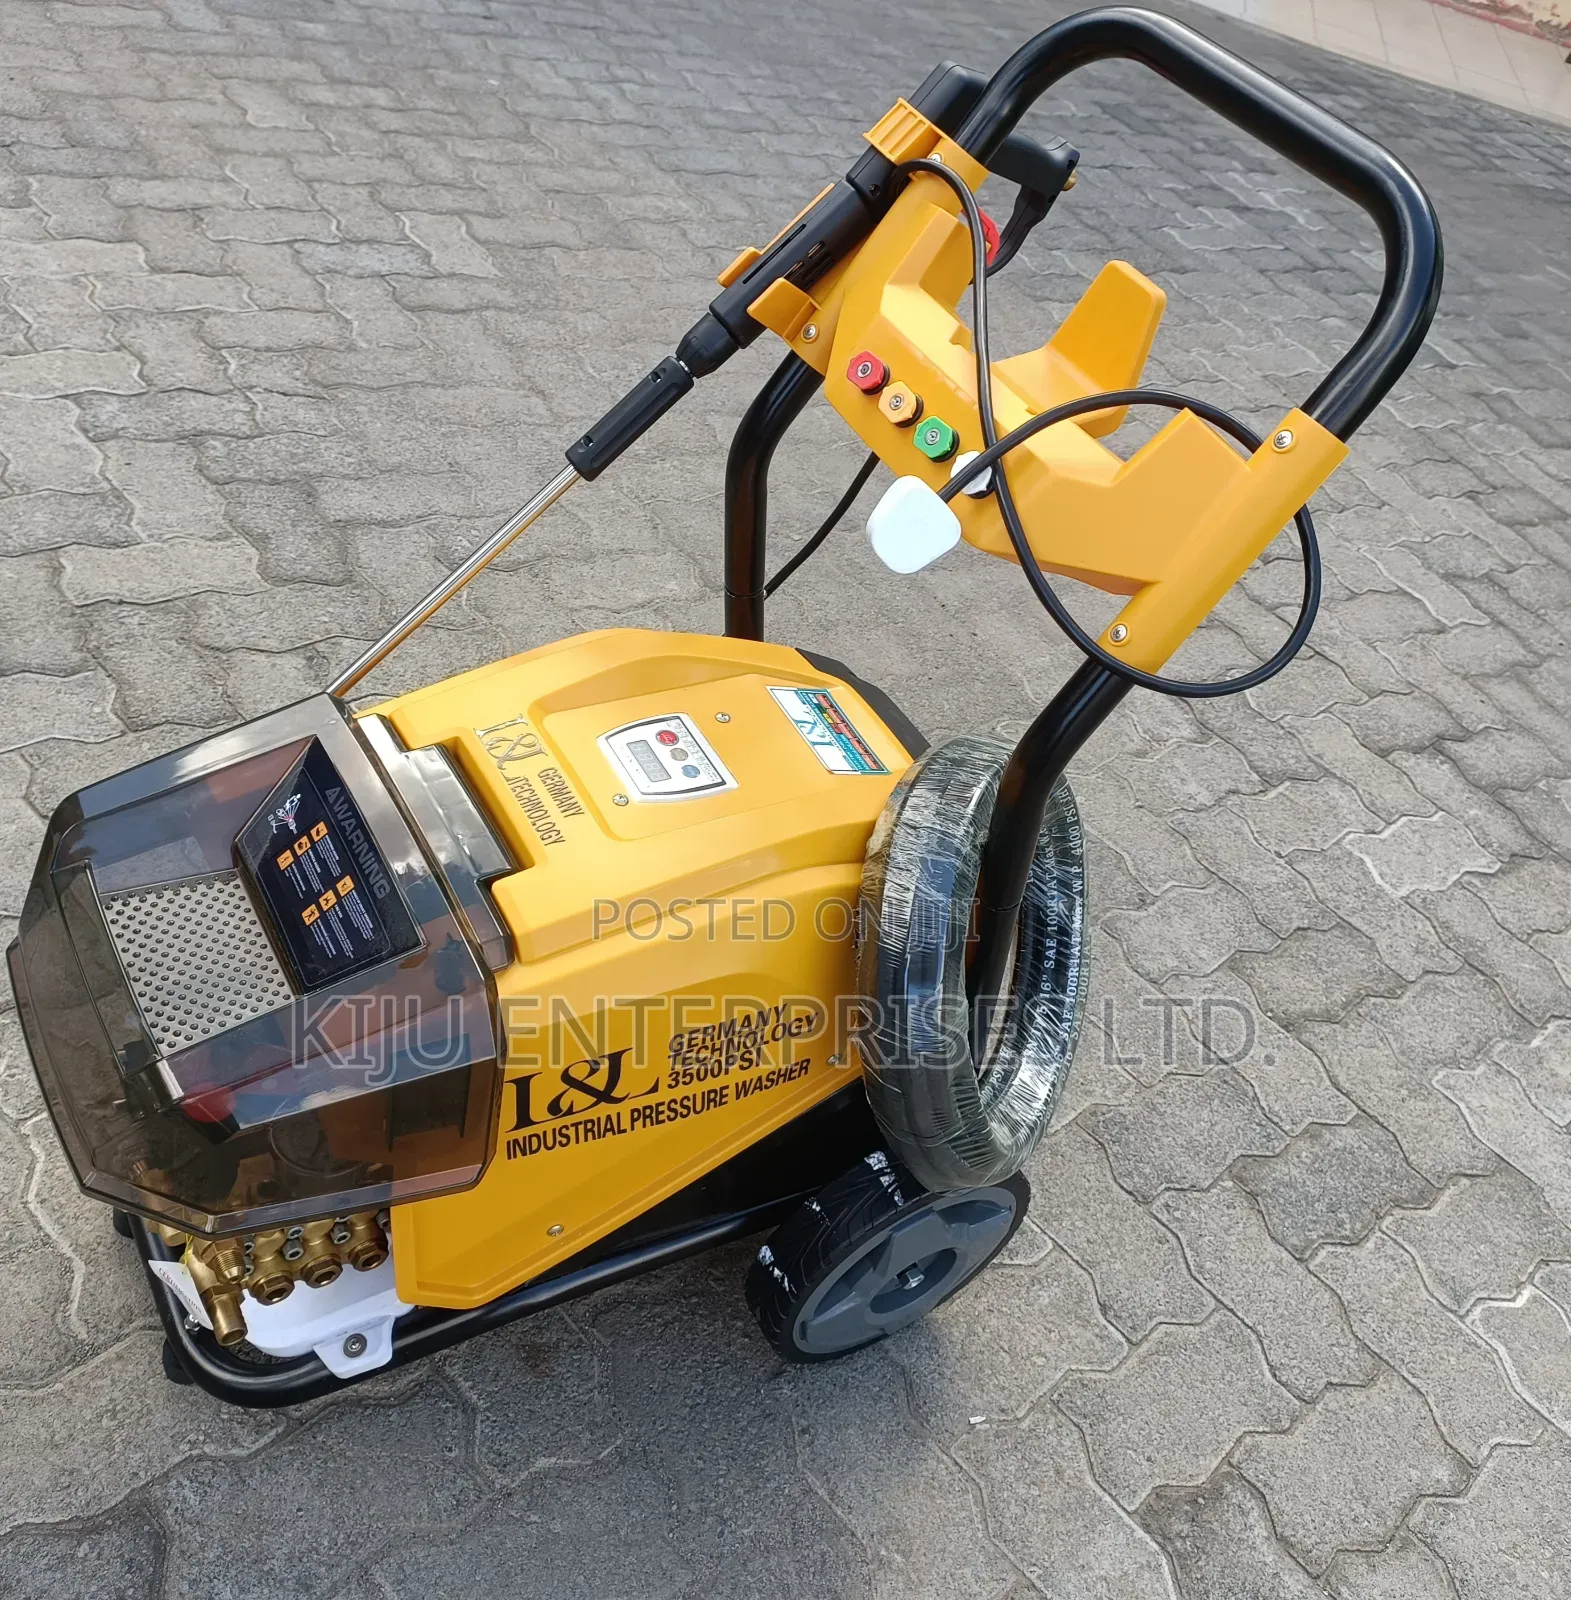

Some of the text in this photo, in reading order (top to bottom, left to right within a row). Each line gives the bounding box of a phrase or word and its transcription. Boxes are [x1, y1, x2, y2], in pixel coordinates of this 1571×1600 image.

[508, 775, 566, 847] TECHNOLOGY
[537, 767, 585, 818] GERMANY
[1063, 803, 1079, 824] PSI
[333, 795, 391, 900] WARNING
[1070, 825, 1084, 856] 4000
[1072, 860, 1083, 893] W.P.
[1044, 938, 1057, 969] SAE
[668, 1012, 818, 1071] TECHNOLOGY
[669, 1003, 788, 1054] GERMANY
[1060, 1009, 1074, 1041] SAE
[505, 1047, 660, 1134] I&L
[667, 1046, 762, 1090] 3500PSI
[506, 1058, 811, 1161] INDUSTRIAL PRESSURE WASHER
